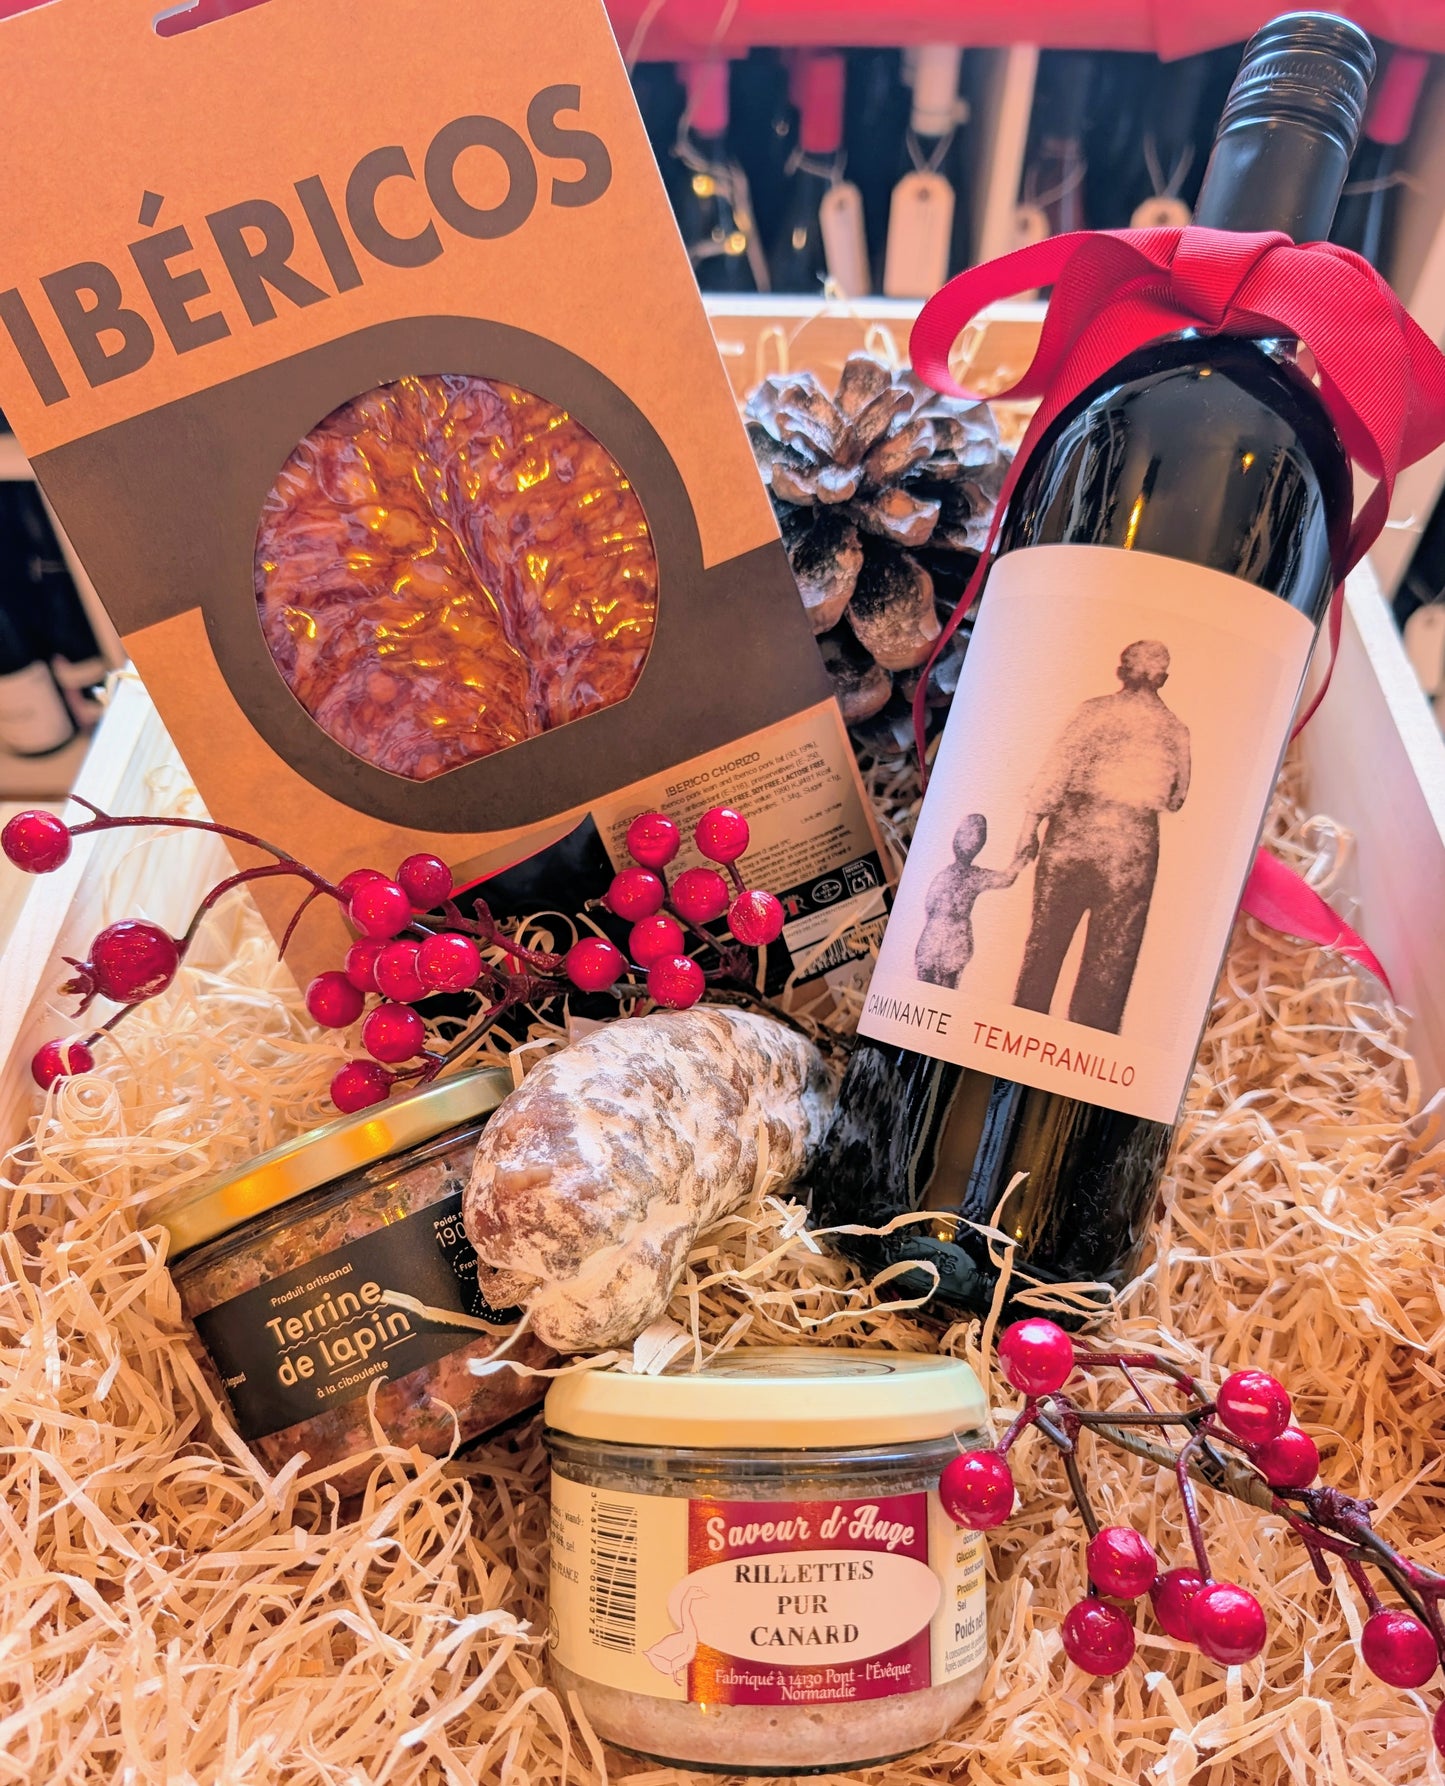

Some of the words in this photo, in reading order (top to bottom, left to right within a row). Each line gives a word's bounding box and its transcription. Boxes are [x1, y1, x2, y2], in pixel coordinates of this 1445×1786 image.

[0, 84, 612, 406] IBÉRICOS
[664, 772, 710, 797] IBERICO
[710, 751, 760, 778] CHORIZO
[685, 789, 703, 802] pork
[719, 777, 732, 786] and
[733, 766, 757, 780] Iberico
[757, 759, 775, 771] pork
[774, 754, 784, 763] fat
[733, 791, 751, 803] FREE,
[751, 785, 764, 795] SOY
[763, 778, 782, 790] FREE,
[781, 766, 810, 782] LACTOSE
[809, 759, 825, 770] FREE
[750, 762, 795, 785] preservatives
[868, 994, 952, 1035] CAMINANTE
[973, 1022, 1135, 1087] TEMPRANILLO
[434, 1215, 457, 1230] Poids
[271, 1285, 305, 1307] Produit
[306, 1263, 353, 1291] artisanal
[266, 1281, 382, 1345] Terrine
[278, 1356, 315, 1388] de
[319, 1311, 411, 1366] lapin
[317, 1387, 324, 1398] à
[326, 1385, 337, 1395] la
[338, 1360, 389, 1390] ciboulette
[706, 1515, 811, 1551] Saveur
[820, 1504, 915, 1550] d'Auge
[956, 1547, 977, 1563] Glucides
[733, 1560, 874, 1584] RILLETTES
[777, 1594, 829, 1615] PUR
[957, 1600, 967, 1611] Sel
[750, 1624, 859, 1647] CANARD
[955, 1616, 975, 1642] Poids
[715, 1667, 775, 1690] Fabriqué
[776, 1672, 784, 1686] à
[788, 1673, 823, 1688] 14130
[826, 1668, 855, 1687] Pont
[866, 1661, 911, 1681] l'Évêque
[781, 1682, 857, 1700] Normandie
